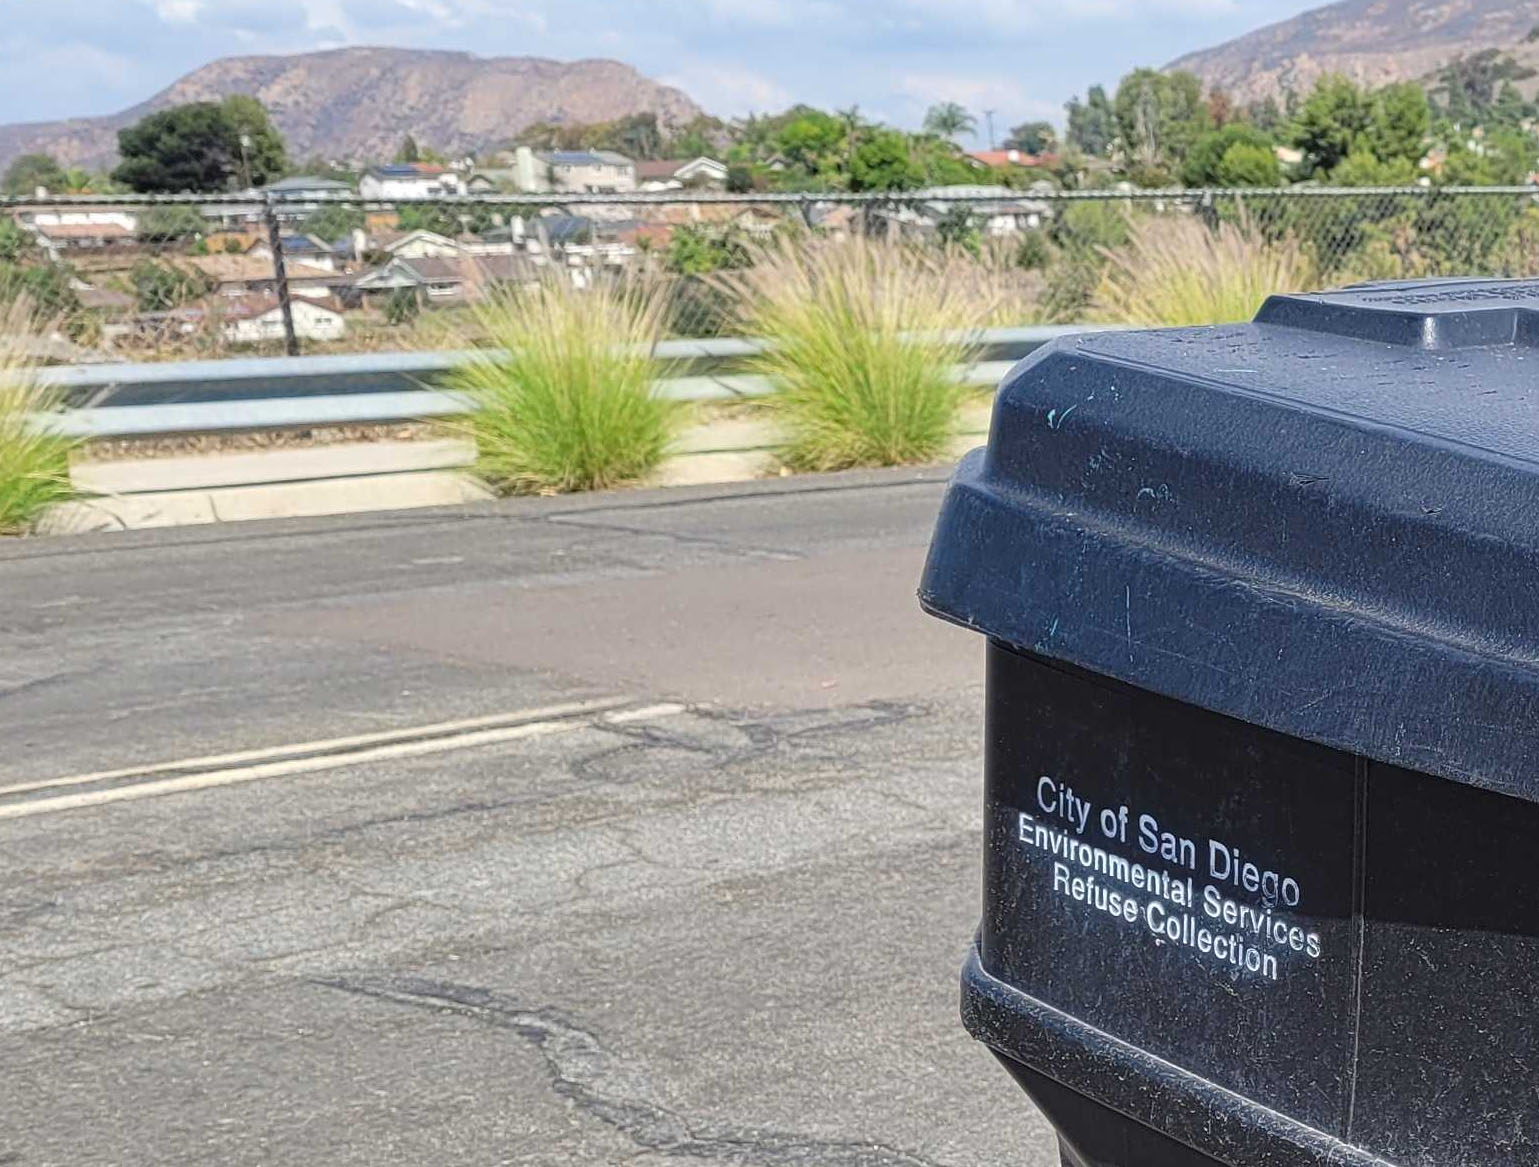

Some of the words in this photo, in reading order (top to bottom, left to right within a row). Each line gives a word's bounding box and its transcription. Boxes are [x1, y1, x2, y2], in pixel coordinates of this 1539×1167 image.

[1018, 811, 1193, 908] Environmental
[1203, 885, 1321, 958] Services
[1036, 776, 1091, 833] City
[1100, 805, 1128, 843] of
[1138, 814, 1196, 870] San
[1208, 839, 1301, 907] Diego
[1053, 862, 1138, 923] Refuse
[1146, 903, 1278, 980] Collection
